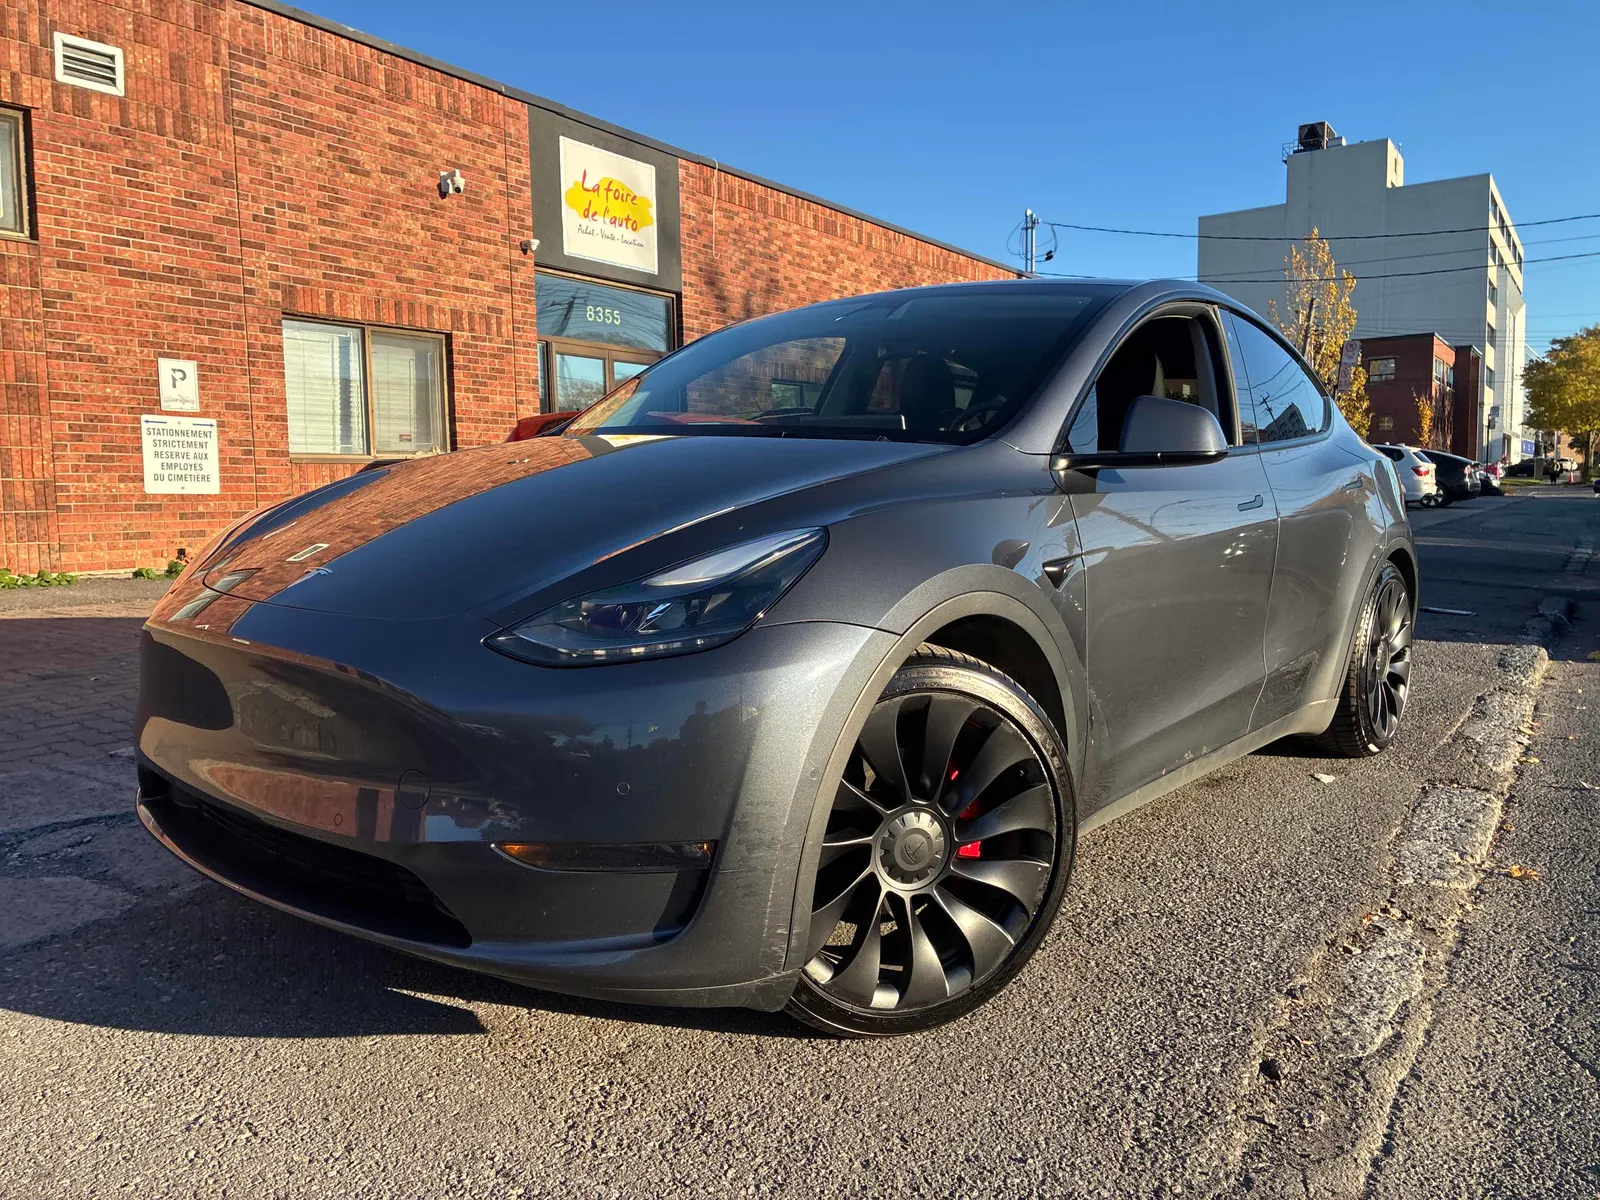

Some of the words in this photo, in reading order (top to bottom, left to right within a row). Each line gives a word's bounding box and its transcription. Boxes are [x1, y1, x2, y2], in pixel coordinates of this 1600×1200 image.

[581, 168, 600, 197] La
[604, 180, 638, 206] foire
[583, 199, 598, 222] de
[603, 205, 638, 232] l'auto
[577, 223, 595, 237] Achat
[600, 228, 616, 241] Vente
[621, 233, 645, 248] Location
[586, 305, 621, 325] 8355
[146, 427, 213, 439] STATIONNEMENT
[152, 439, 209, 450] STRICTEMENT
[193, 452, 209, 461] AUX
[153, 473, 165, 482] DU
